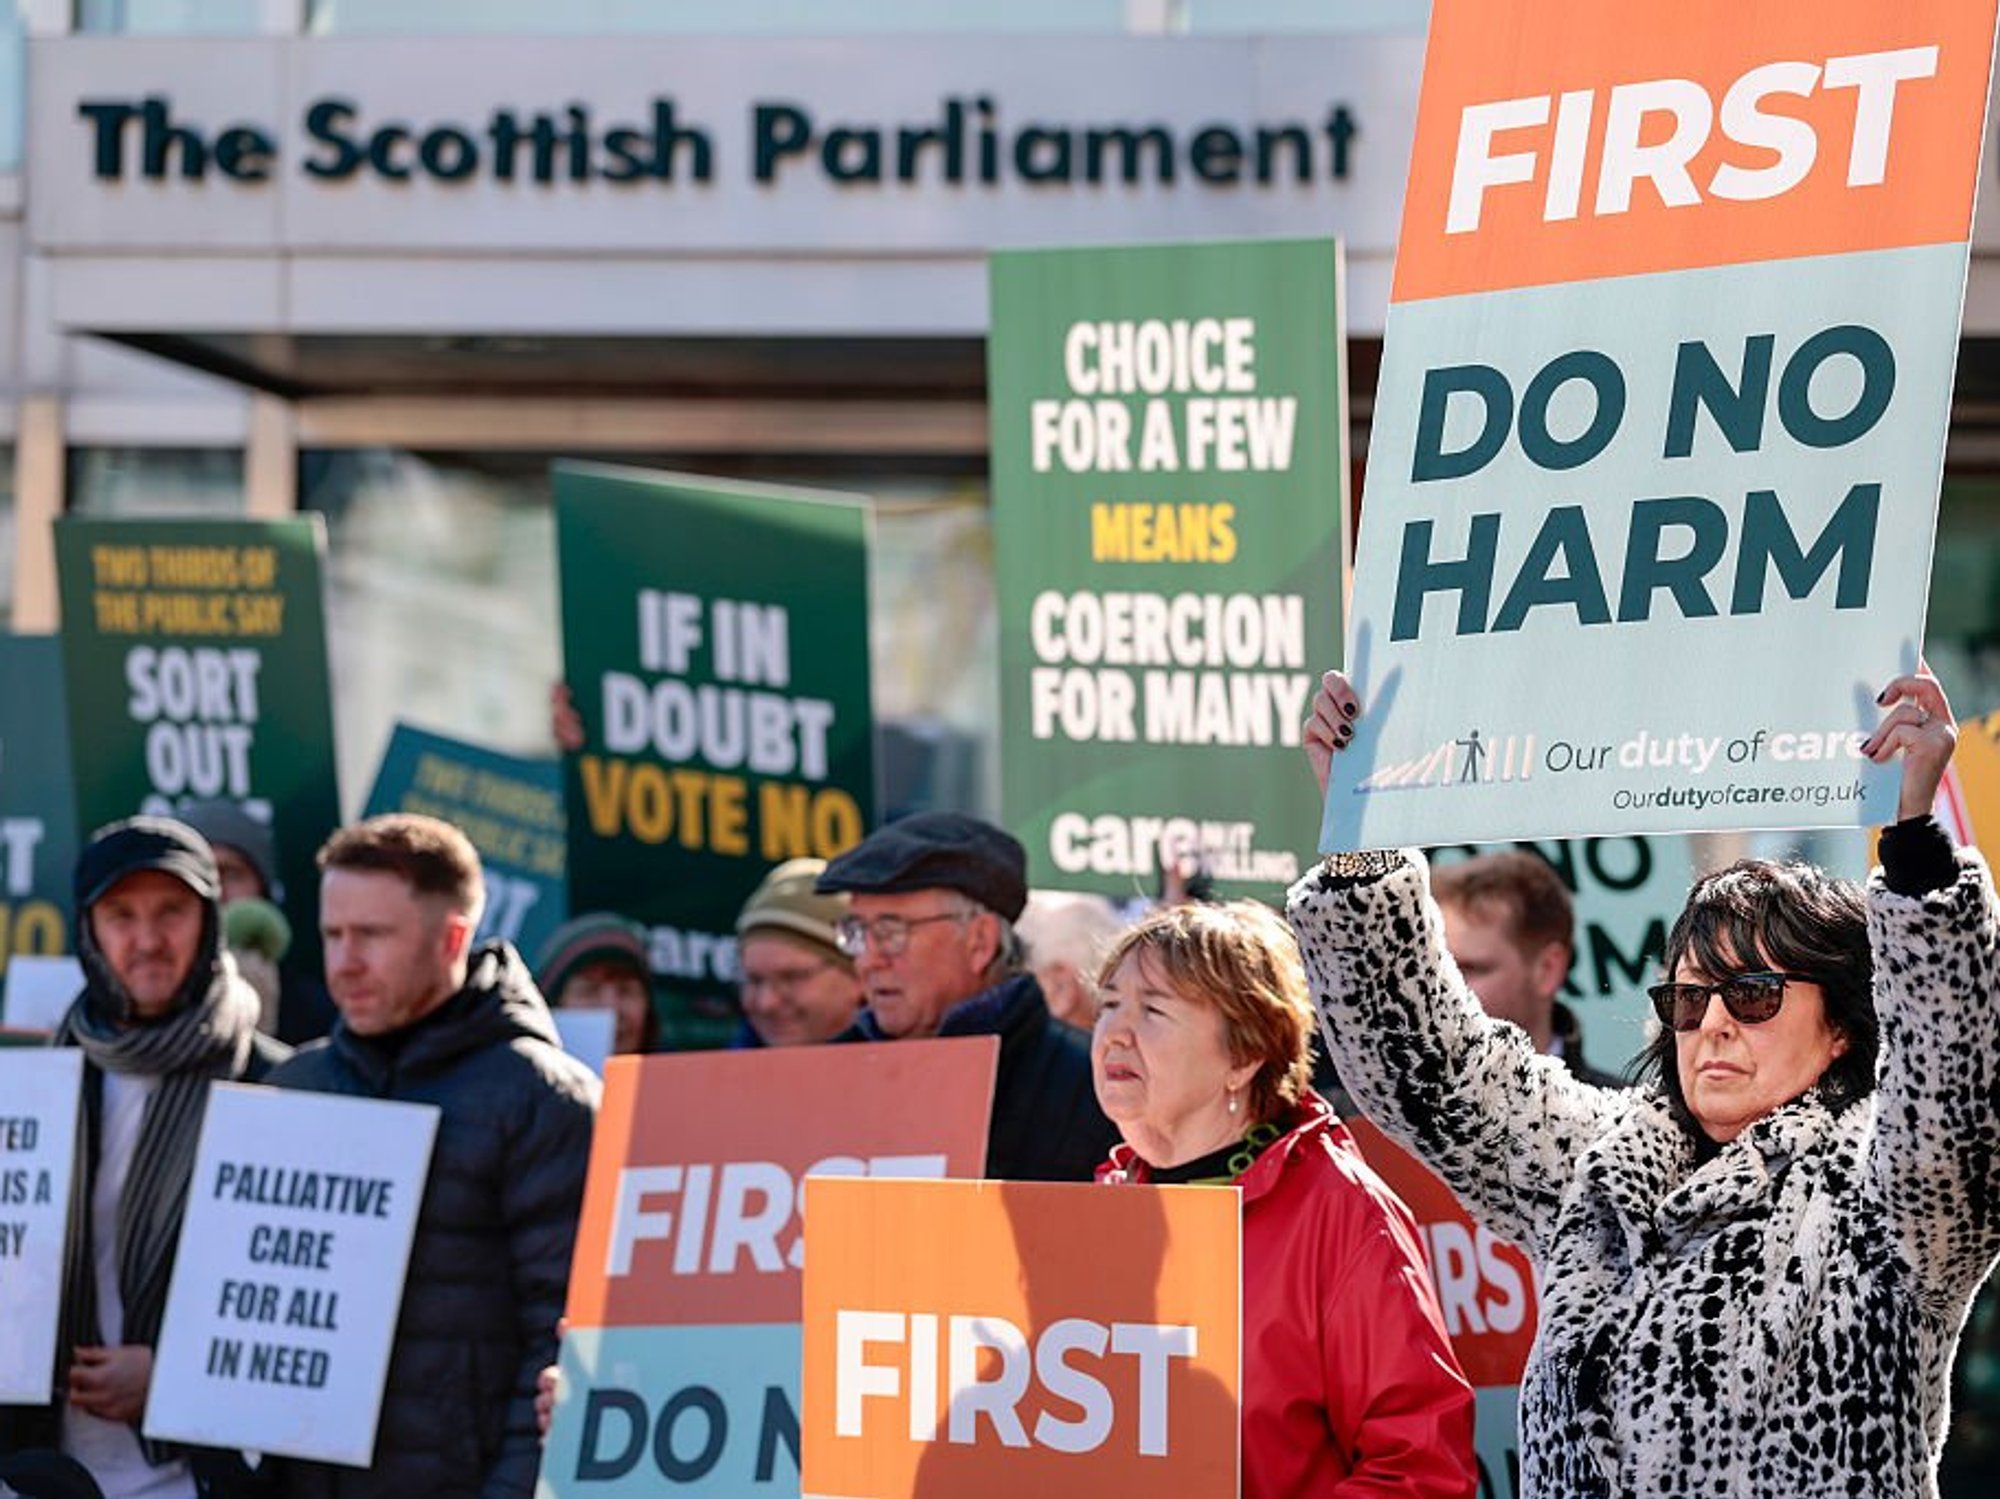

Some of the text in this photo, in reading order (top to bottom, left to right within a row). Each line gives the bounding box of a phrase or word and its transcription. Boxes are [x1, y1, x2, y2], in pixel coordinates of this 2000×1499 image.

[79, 95, 1358, 184] The Scottish Parliament
[1446, 46, 1938, 234] FIRST
[1066, 319, 1256, 395] CHOICE
[1032, 397, 1297, 473] FOR A FEW
[1411, 325, 1896, 483] DO NO
[1092, 503, 1237, 563] MEANS
[1389, 484, 1881, 642] HARM
[637, 589, 791, 687] IF IN
[1031, 592, 1305, 668] COERCION
[126, 645, 260, 722] SORT
[1031, 668, 1310, 746] FOR MANY
[146, 720, 254, 797] OUT
[602, 670, 834, 781] DOUBT
[1546, 730, 1872, 773] Our duty of care
[580, 755, 864, 860] VOTE NO
[1613, 780, 1867, 809] Ourdutyofcare.org.uk
[1050, 813, 1200, 877] care
[34, 1169, 51, 1204] A
[214, 1162, 394, 1218] PALLIATIVE
[605, 1155, 946, 1277] FIR
[249, 1224, 334, 1270] CARE
[217, 1280, 338, 1331] FOR ALL
[206, 1337, 330, 1390] IN NEED
[836, 1310, 1197, 1456] FIRST
[574, 1385, 727, 1483] DO
